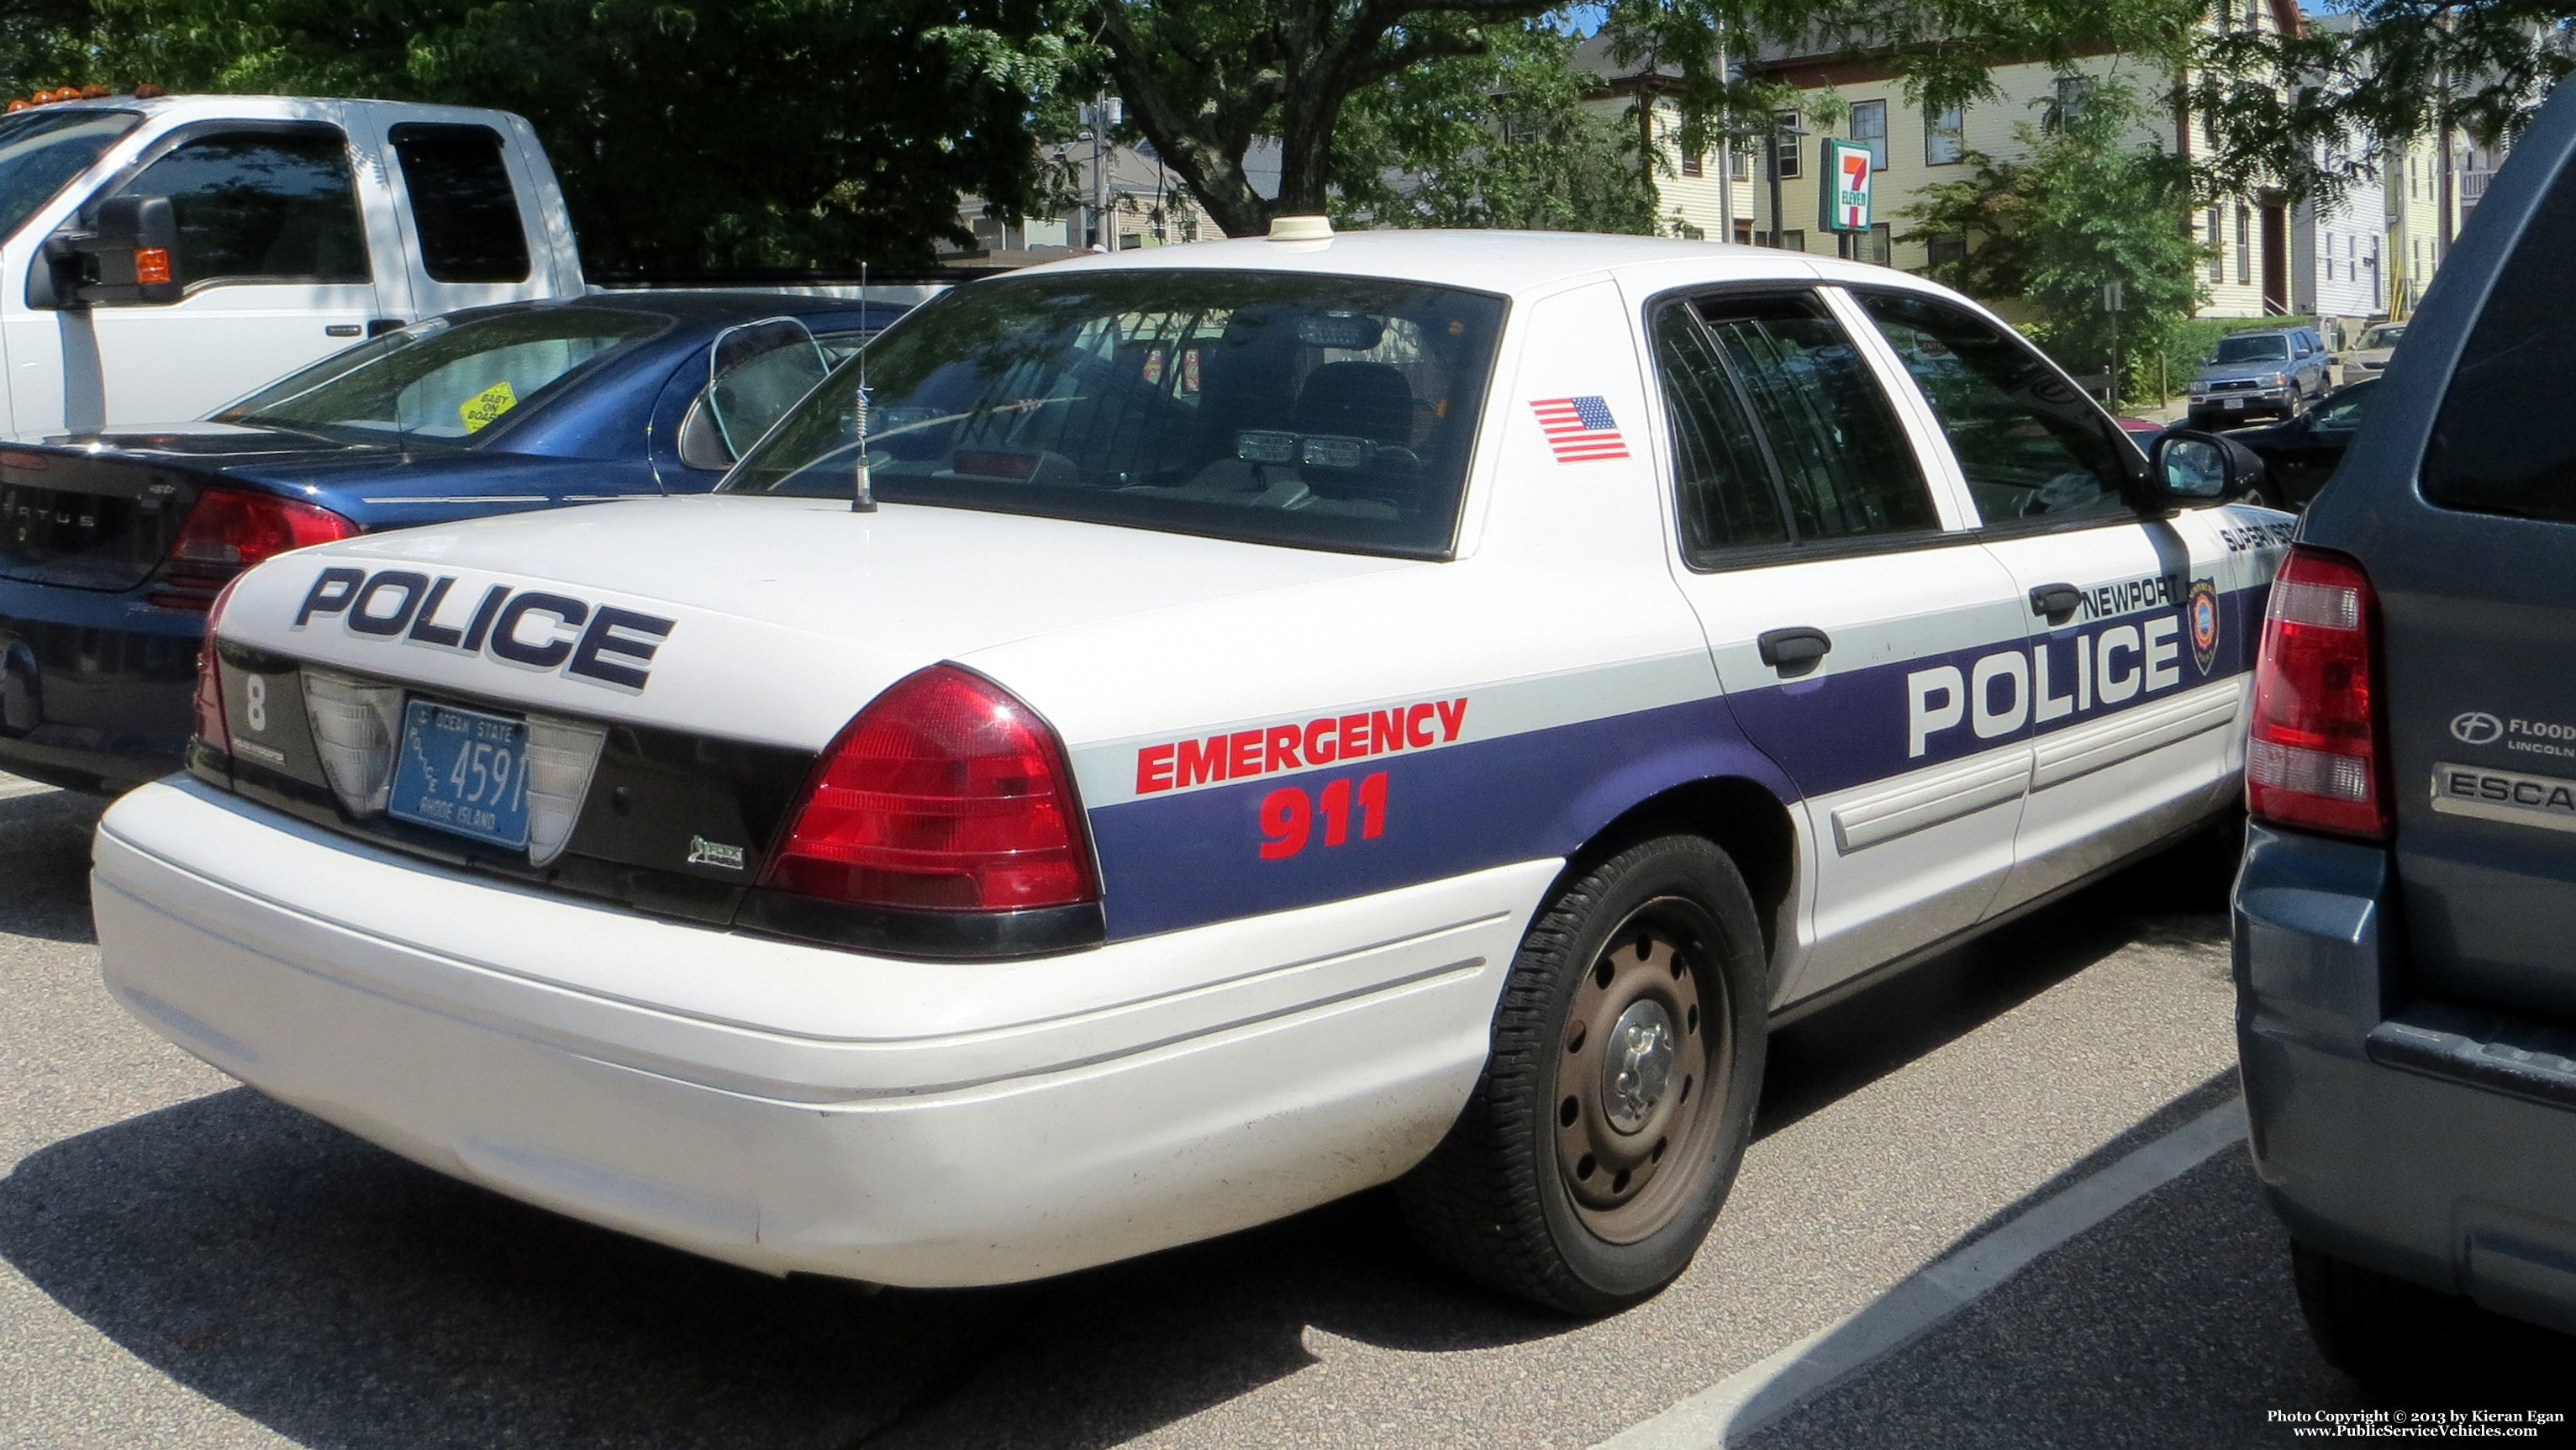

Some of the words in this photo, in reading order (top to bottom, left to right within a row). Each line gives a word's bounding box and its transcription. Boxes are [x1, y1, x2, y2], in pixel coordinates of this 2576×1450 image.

[1842, 191, 1866, 206] ELEVEN
[481, 393, 510, 404] BABY
[483, 403, 499, 413] ON
[2081, 573, 2178, 620] NEWPORT
[290, 566, 677, 697] POLICE
[247, 673, 266, 731] 8
[1907, 614, 2179, 758] POLICE
[477, 720, 514, 743] STATE
[1135, 697, 1468, 794] EMERGENCY
[2508, 740, 2576, 757] LINCOLN
[2509, 719, 2576, 741] FLOOD
[450, 739, 530, 812] 4591
[2449, 772, 2575, 811] ESCA
[420, 797, 455, 820] RHODE
[457, 805, 497, 830] ISLAND
[1259, 772, 1388, 859] 911
